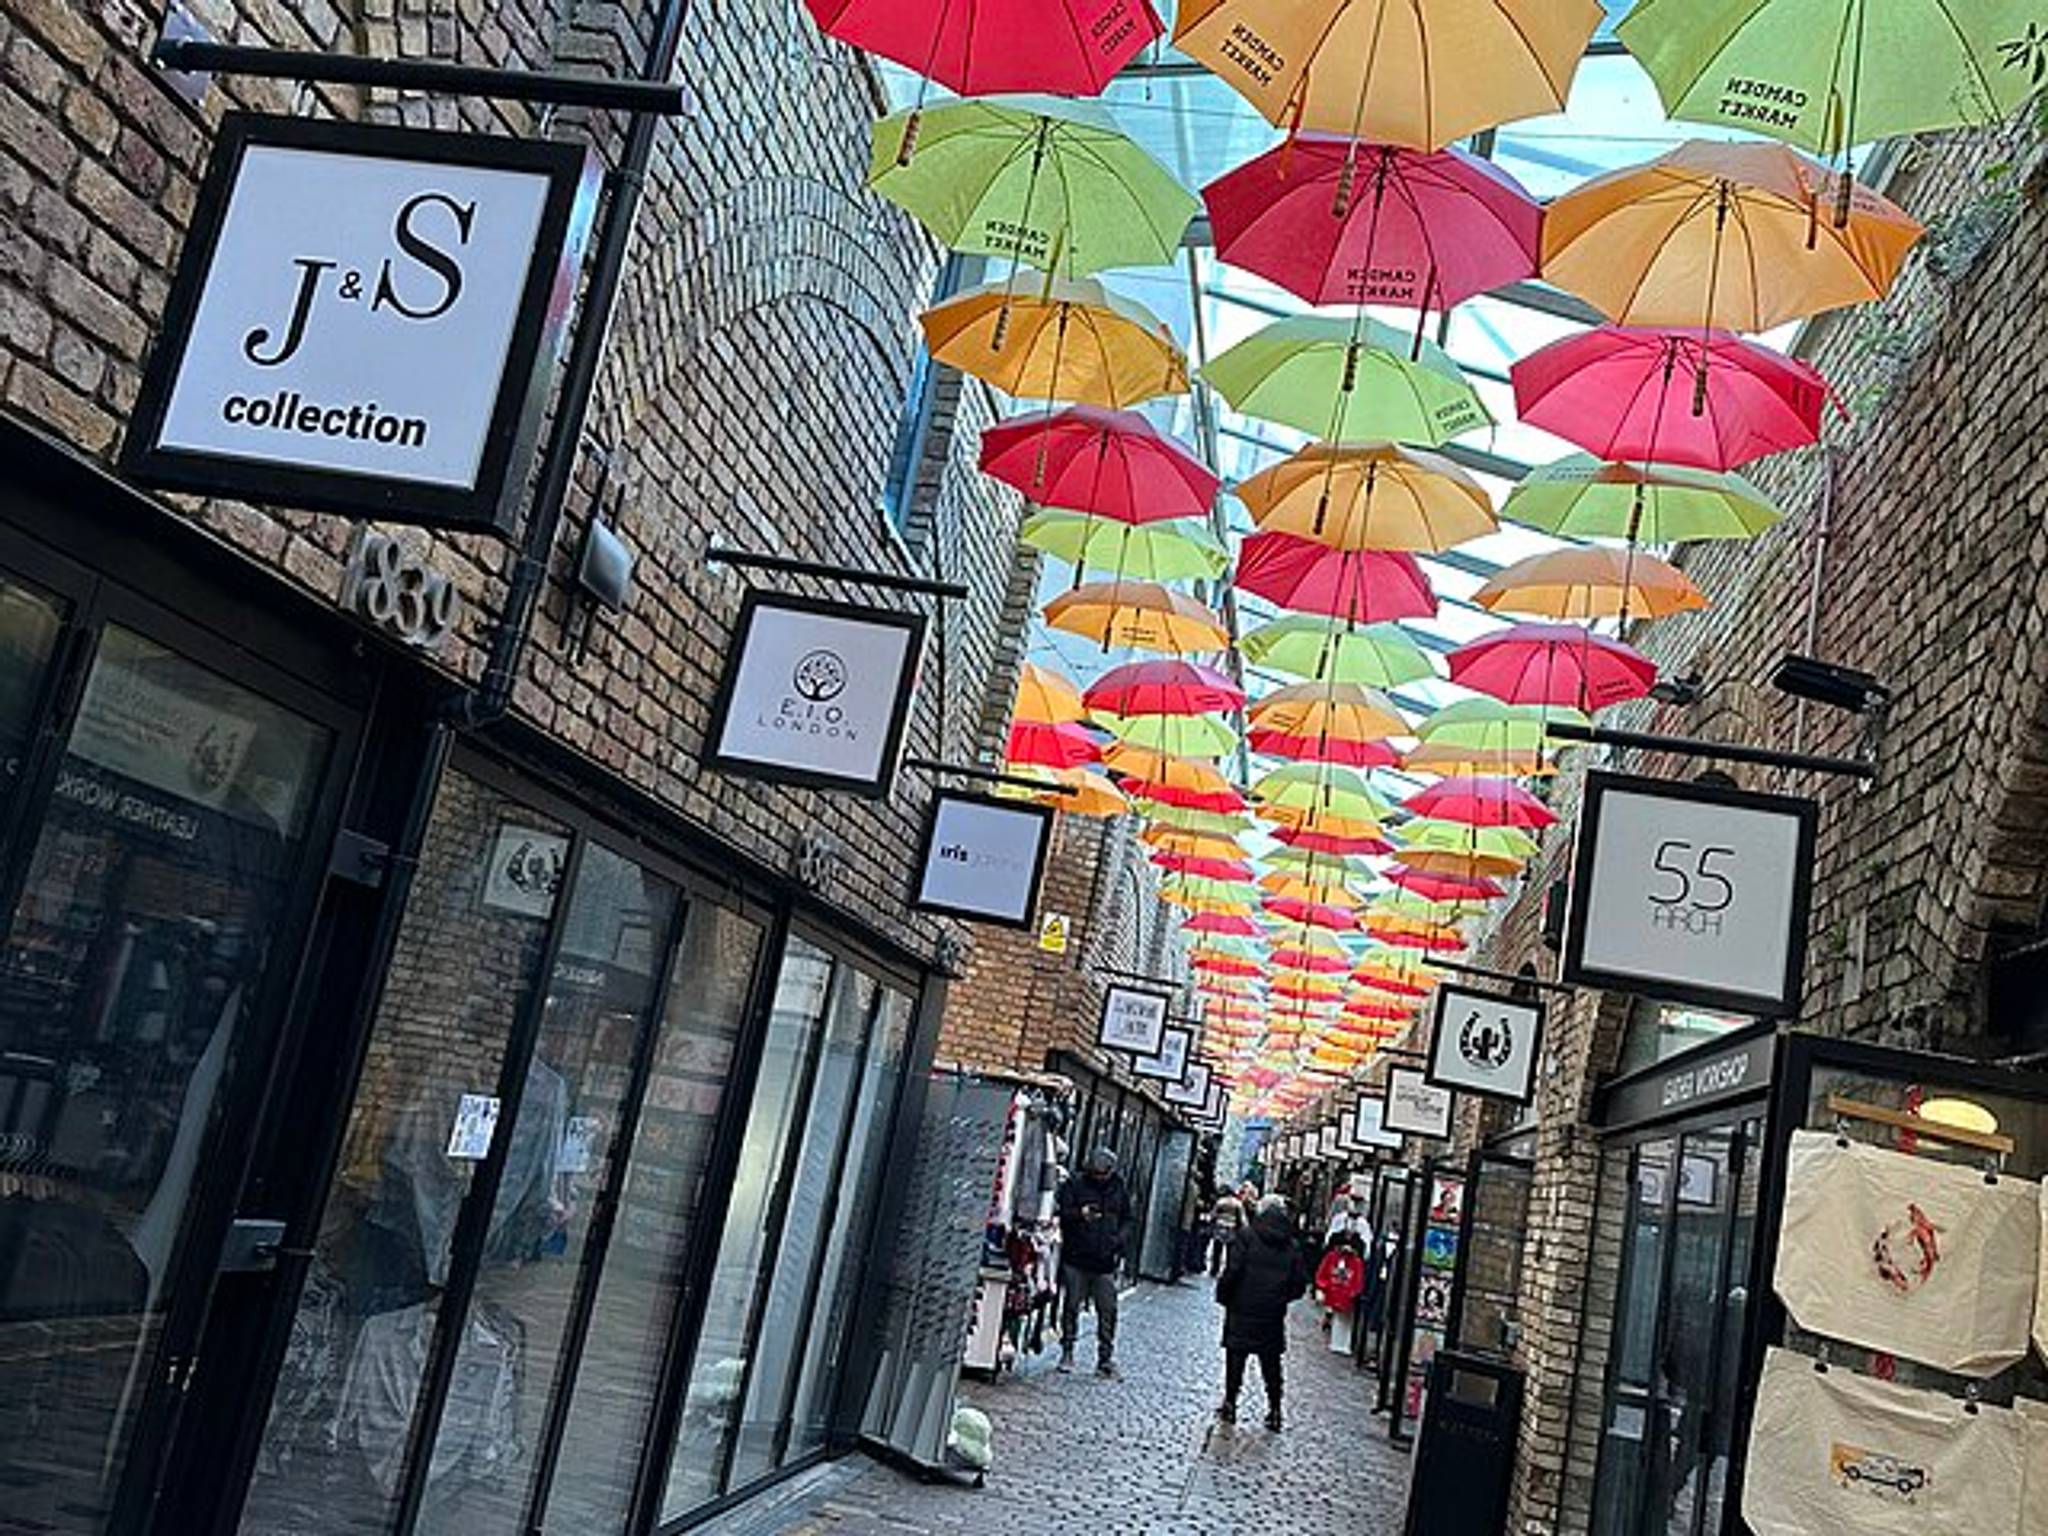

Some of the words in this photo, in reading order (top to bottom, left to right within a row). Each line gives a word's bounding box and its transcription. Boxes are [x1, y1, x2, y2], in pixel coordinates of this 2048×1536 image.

[222, 391, 428, 448] collection
[757, 714, 858, 741] LONDON
[941, 844, 968, 862] iris
[1648, 841, 1735, 911] 55
